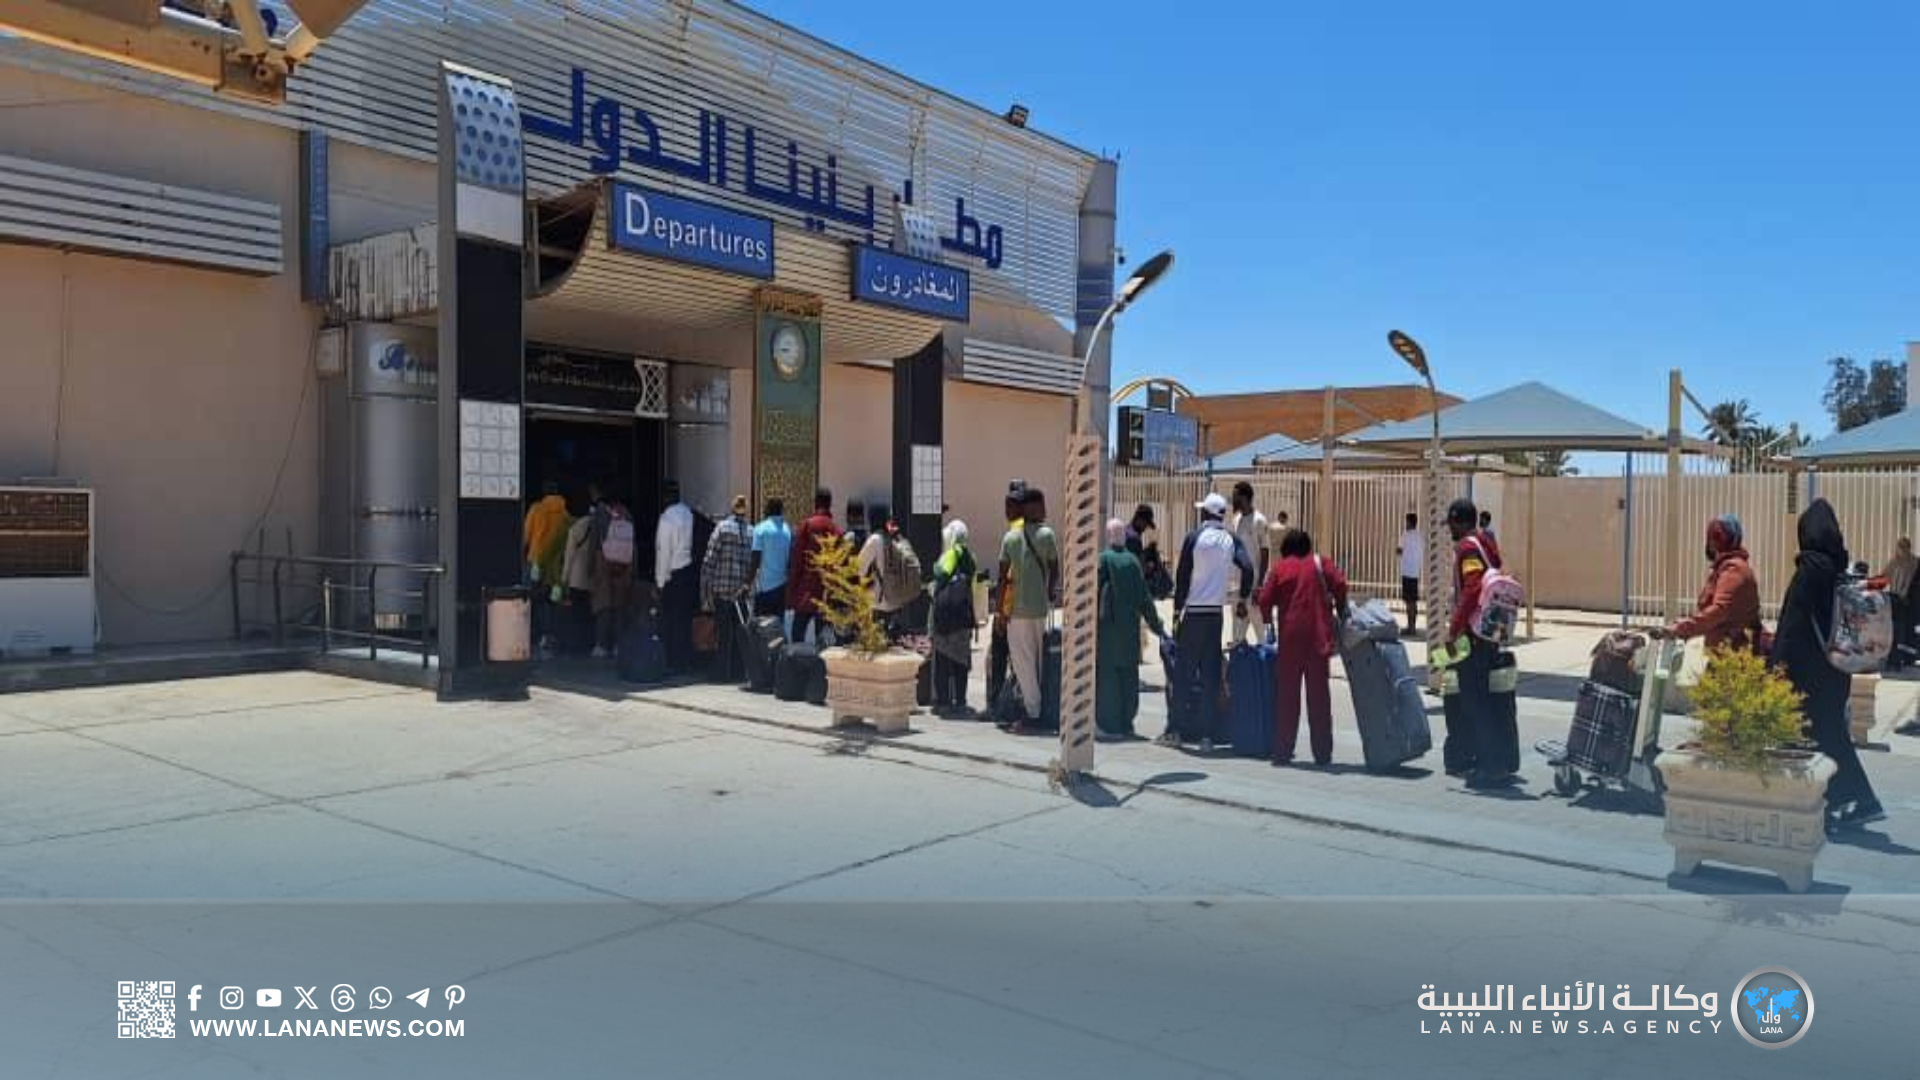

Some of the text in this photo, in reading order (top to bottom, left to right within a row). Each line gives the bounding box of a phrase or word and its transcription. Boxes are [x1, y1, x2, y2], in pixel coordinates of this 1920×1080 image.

[520, 67, 1003, 269] مط بنينا الدول
[624, 191, 767, 262] Departures
[871, 264, 960, 304] المغادرون
